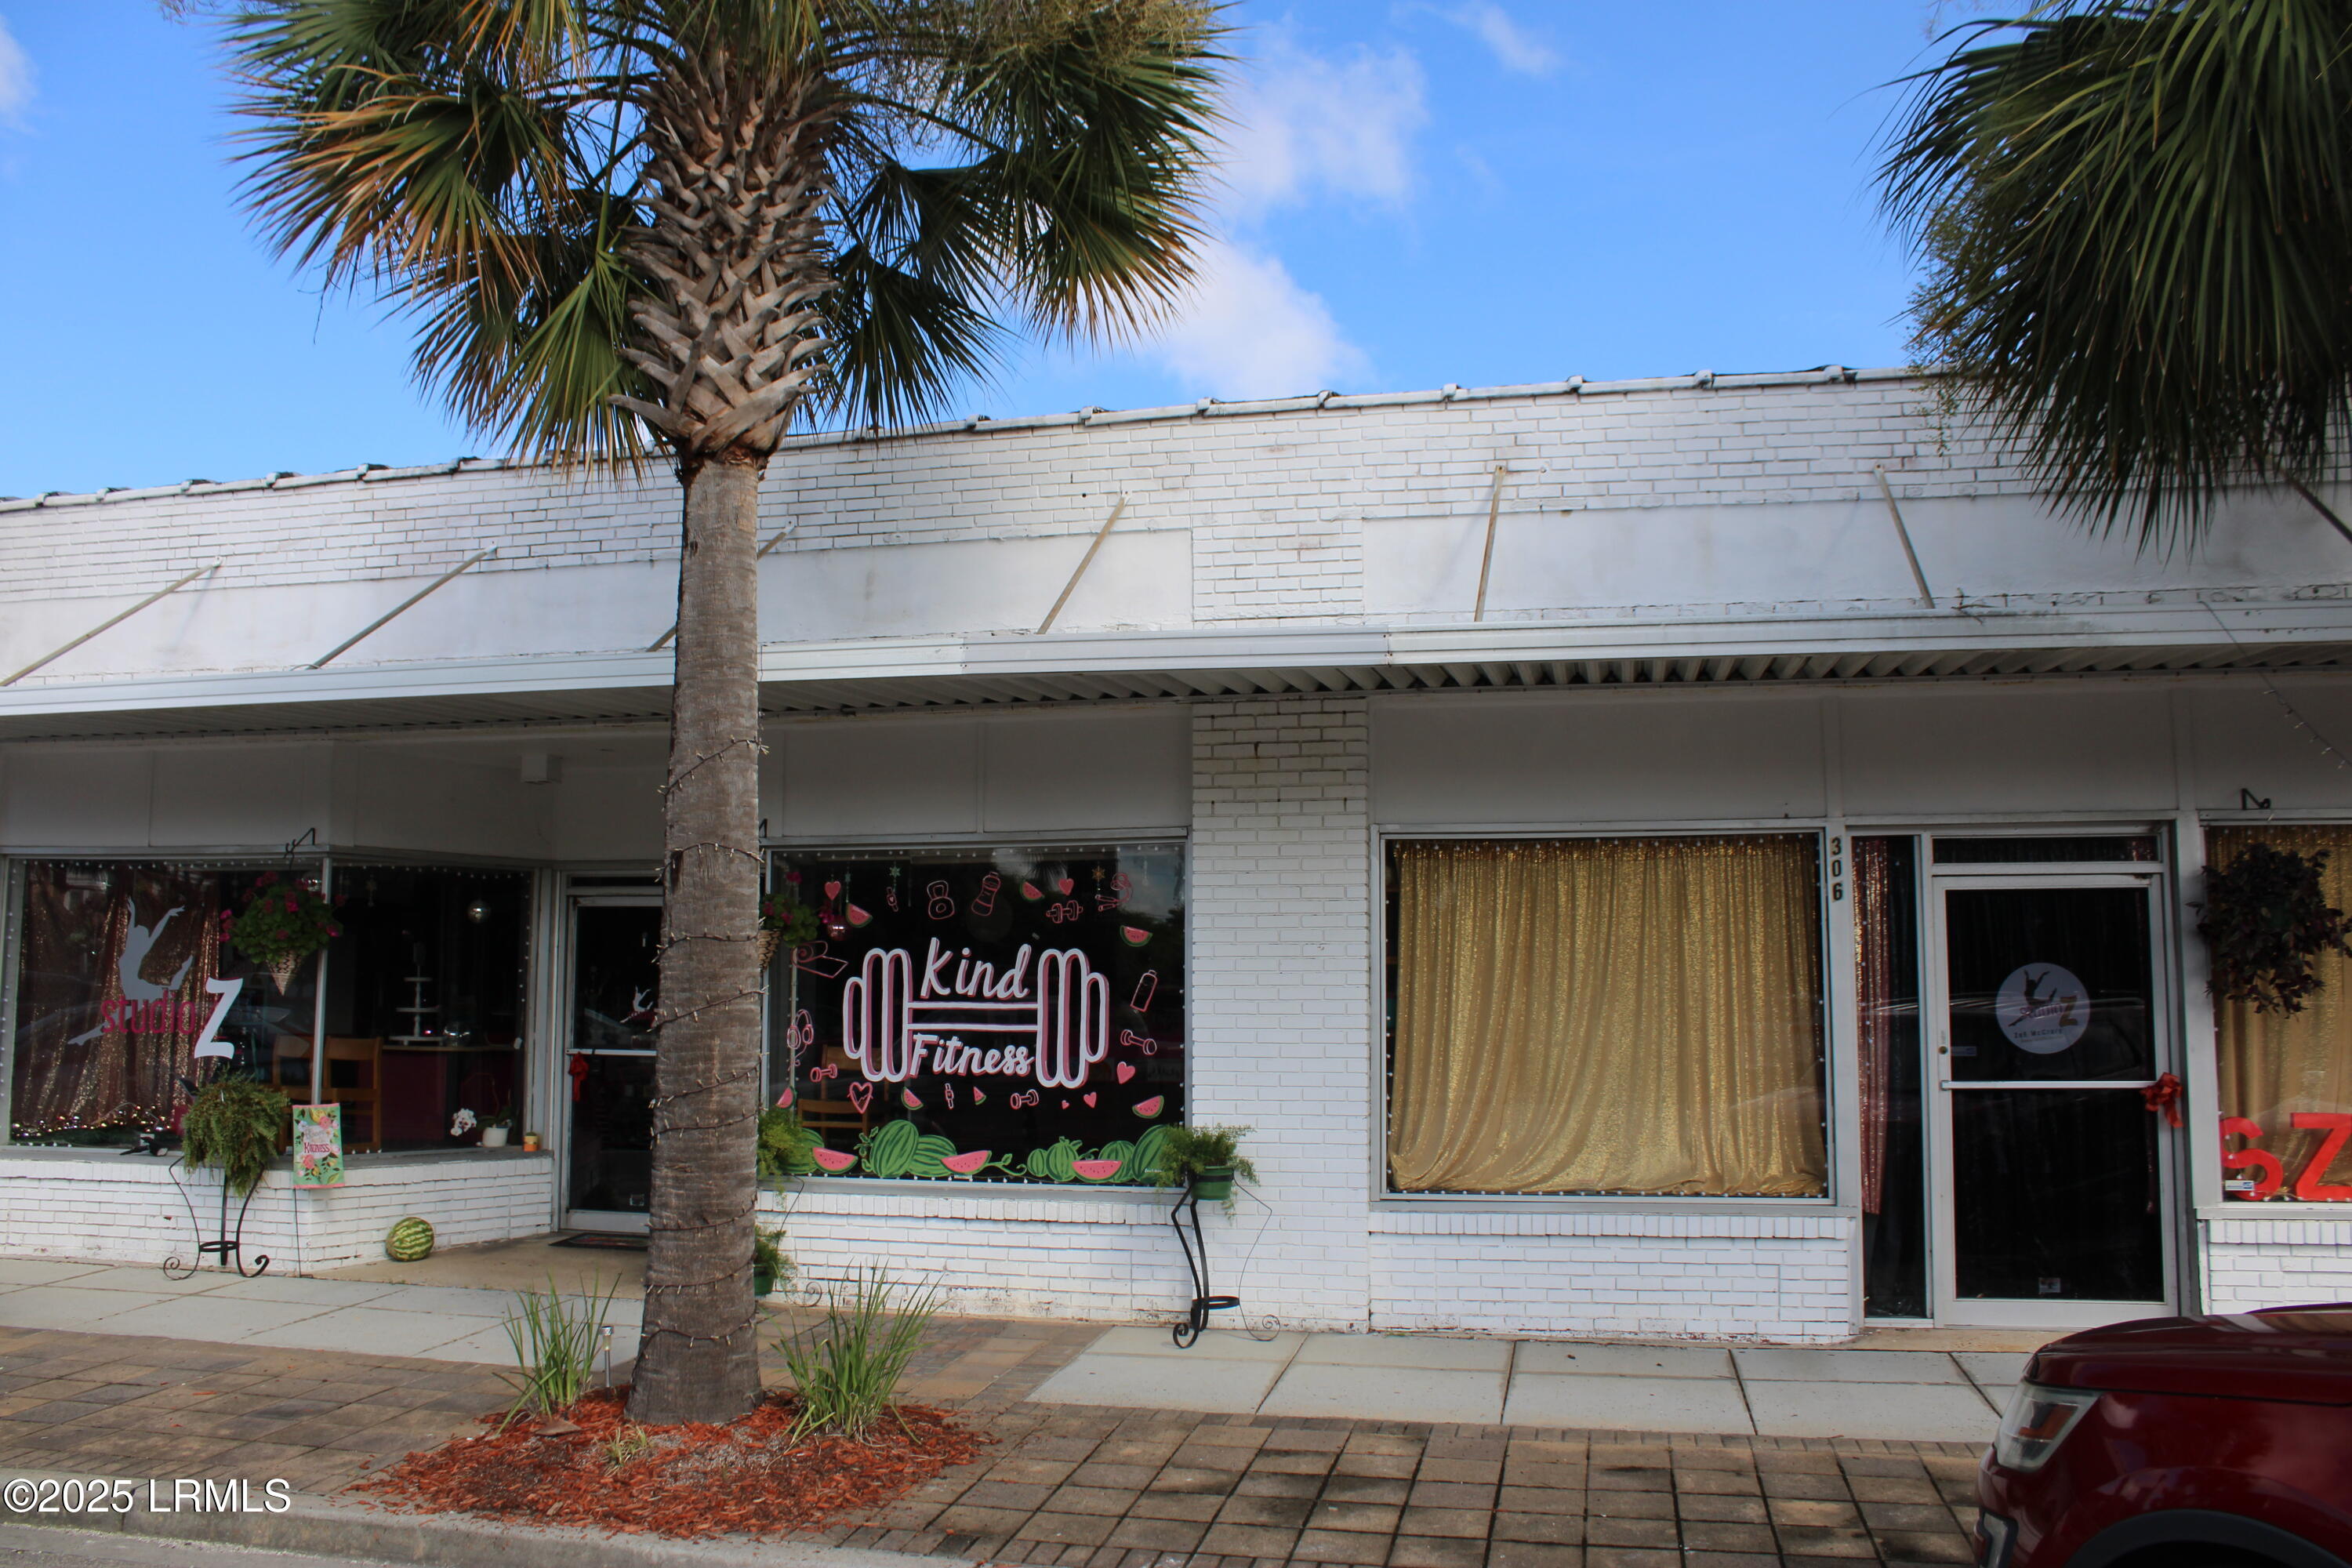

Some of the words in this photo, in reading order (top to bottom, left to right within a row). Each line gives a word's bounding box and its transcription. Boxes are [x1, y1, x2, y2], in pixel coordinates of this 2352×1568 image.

[1831, 837, 1842, 901] 306
[920, 937, 1032, 1000] Kind
[101, 988, 195, 1035] studio
[194, 976, 243, 1059] Z
[909, 1033, 1035, 1078] Fitness
